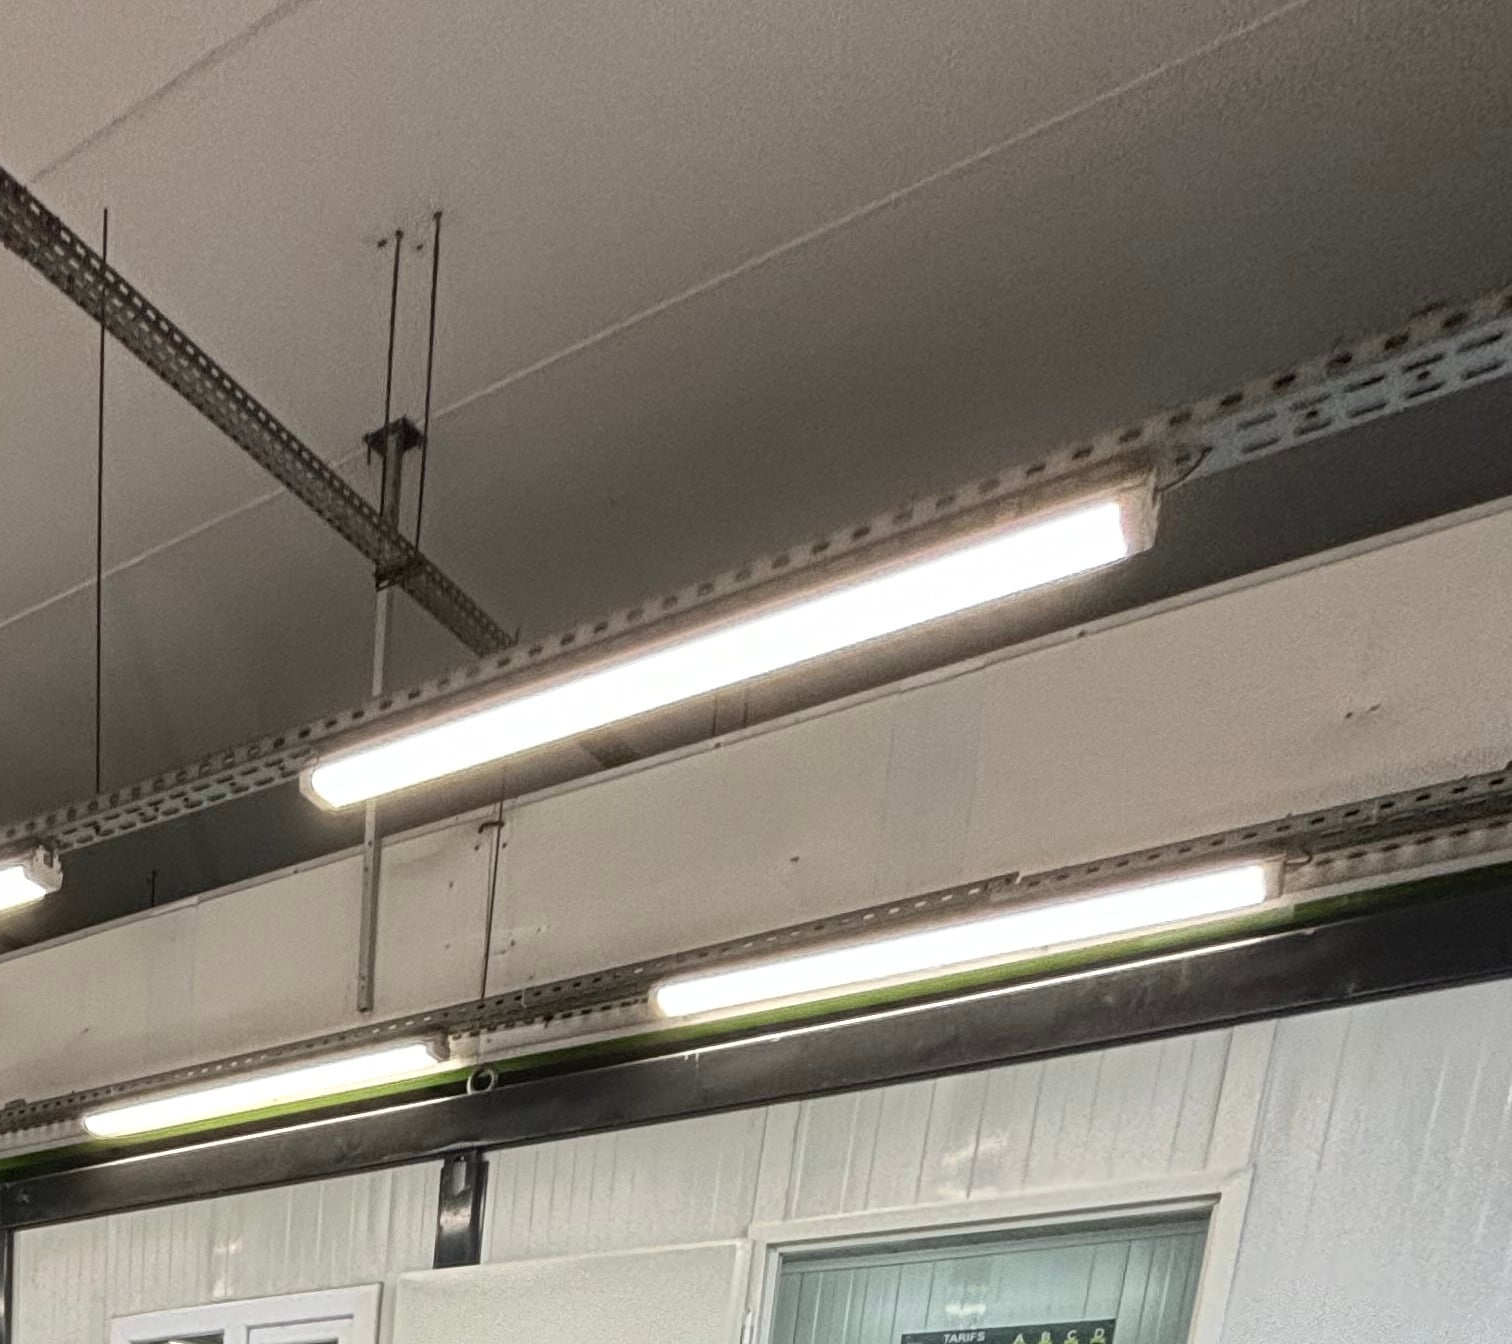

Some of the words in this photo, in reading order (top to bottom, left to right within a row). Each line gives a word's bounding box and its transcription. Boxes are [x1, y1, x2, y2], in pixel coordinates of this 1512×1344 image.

[944, 1331, 986, 1344] TARIFS
[1067, 1329, 1078, 1341] C
[1095, 1327, 1105, 1339] D
